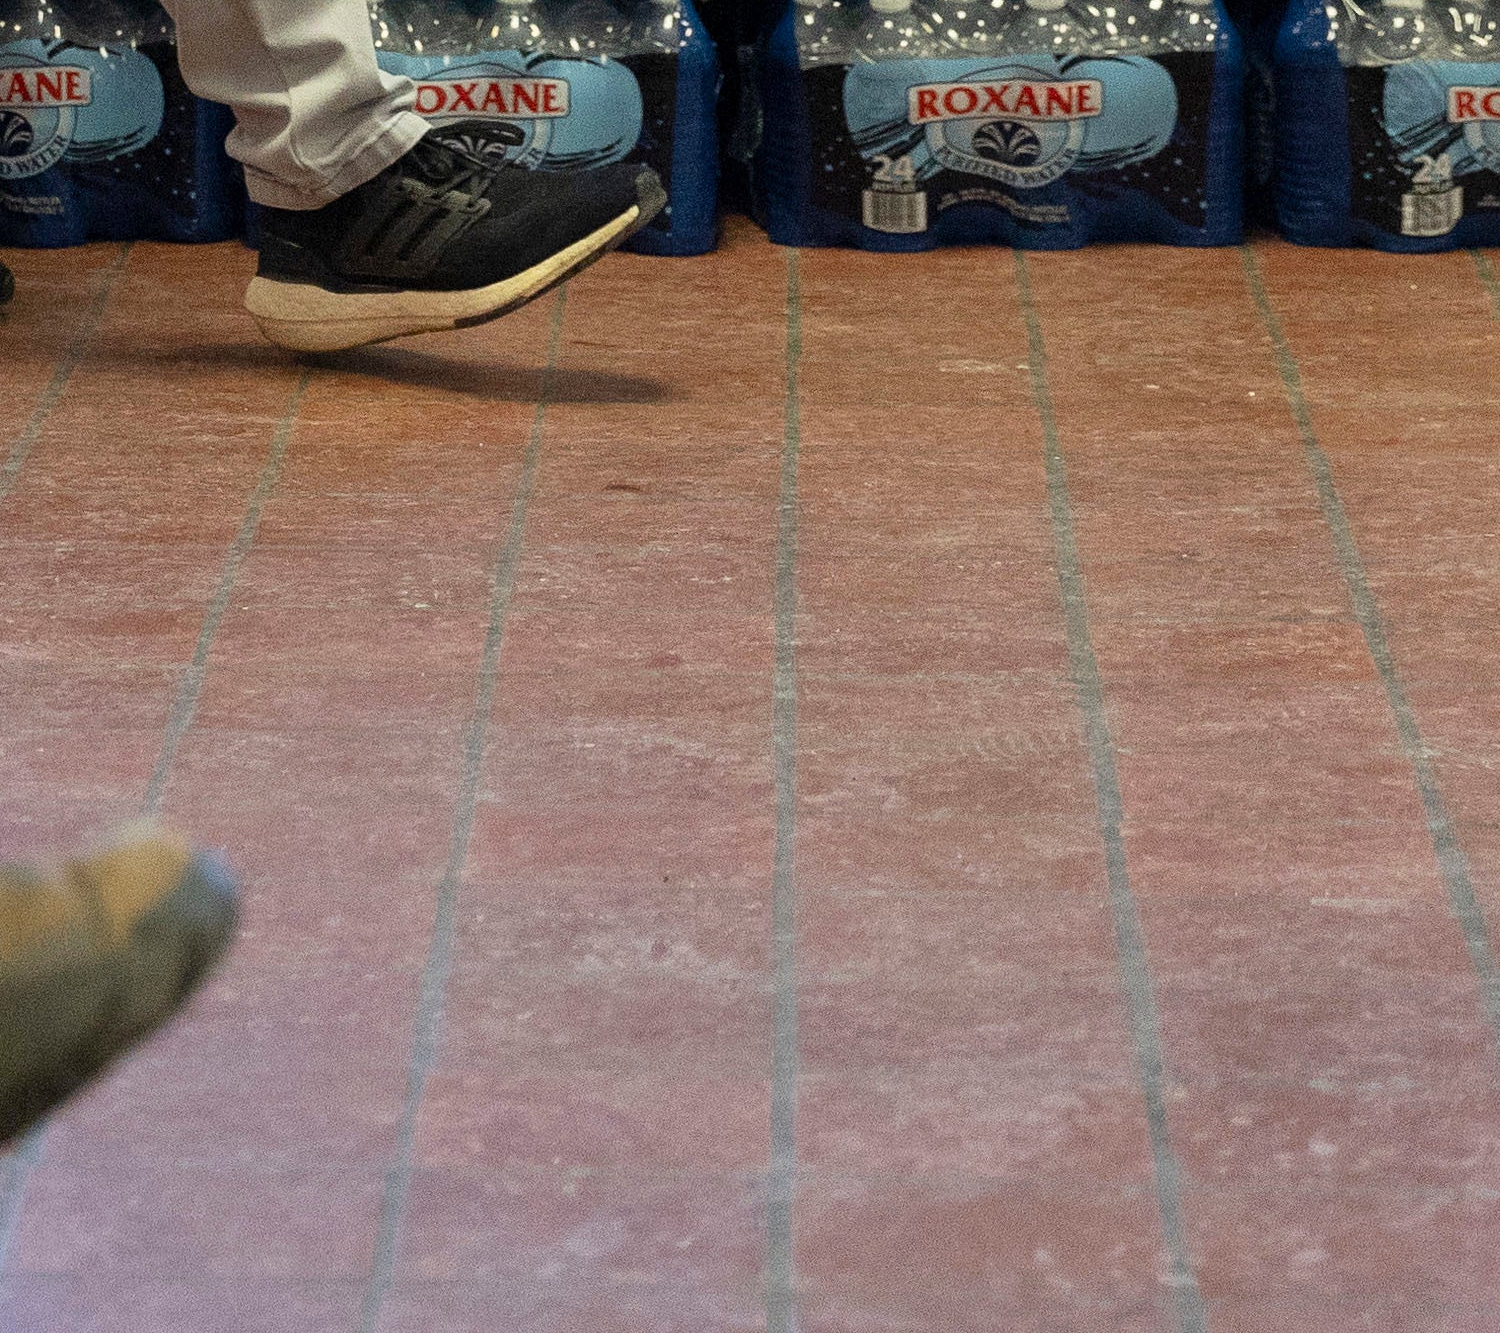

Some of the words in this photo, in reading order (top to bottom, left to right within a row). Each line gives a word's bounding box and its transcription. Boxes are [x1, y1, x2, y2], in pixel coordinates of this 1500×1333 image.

[413, 81, 564, 114] OXANE
[916, 84, 1096, 120] ROXANE
[872, 155, 915, 181] 24
[1414, 155, 1452, 180] 24
